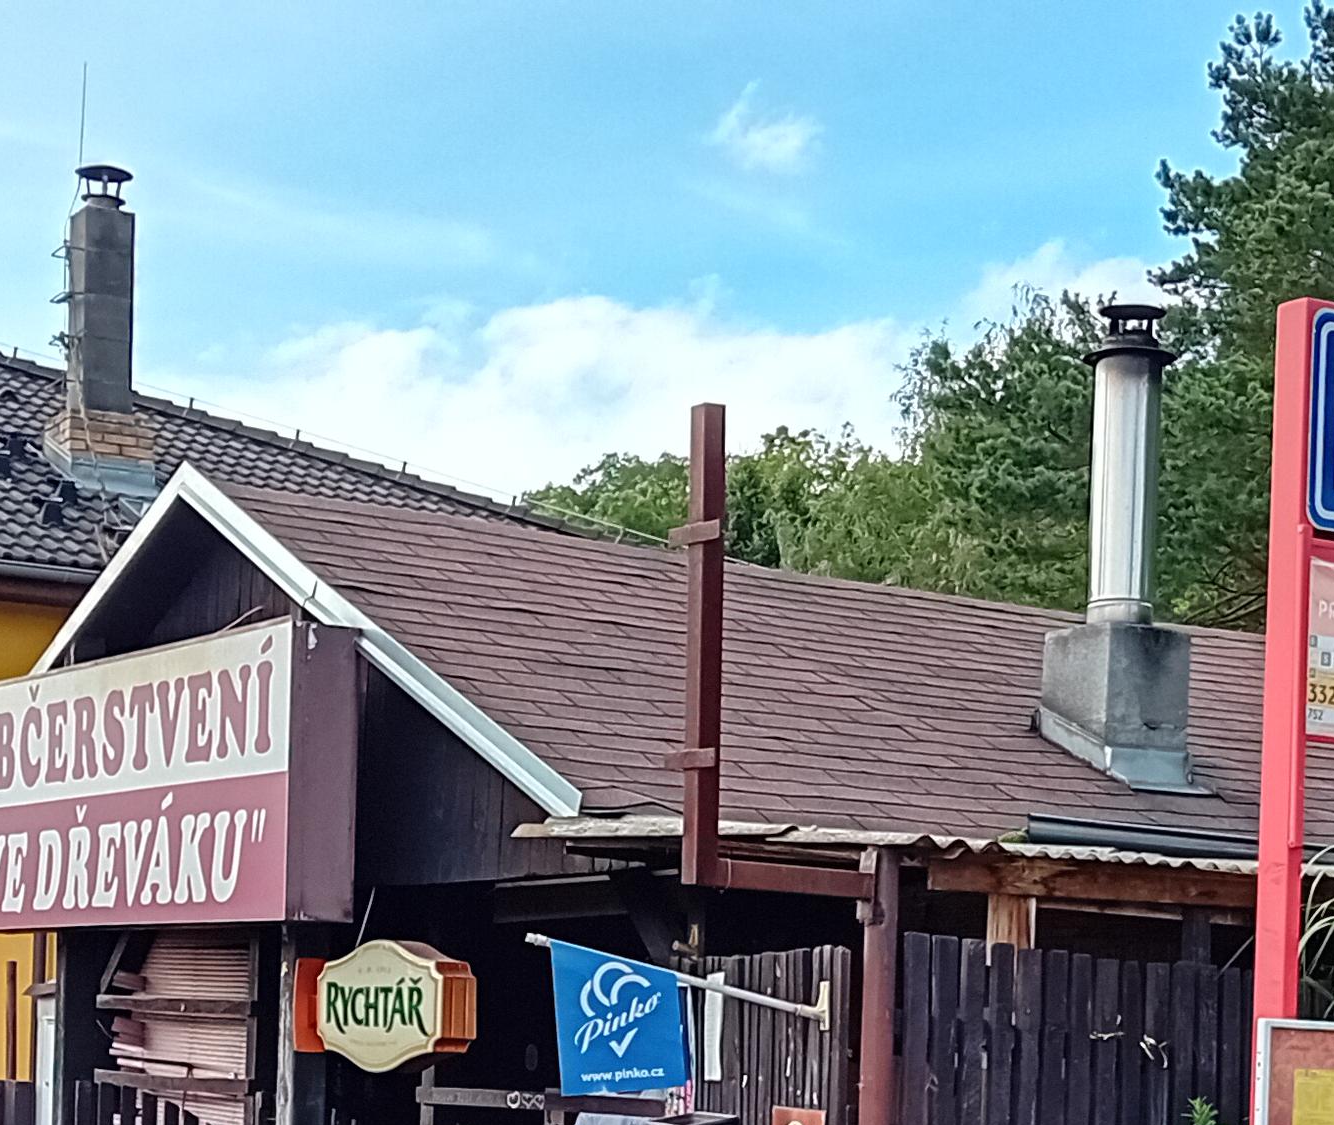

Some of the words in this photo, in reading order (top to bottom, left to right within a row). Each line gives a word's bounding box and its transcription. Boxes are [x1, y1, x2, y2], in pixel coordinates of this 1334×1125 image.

[1308, 708, 1324, 721] 752
[326, 977, 430, 1037] RYCHTÁŘ
[574, 993, 660, 1054] Pinko
[581, 1067, 665, 1083] www.pinko.cz
